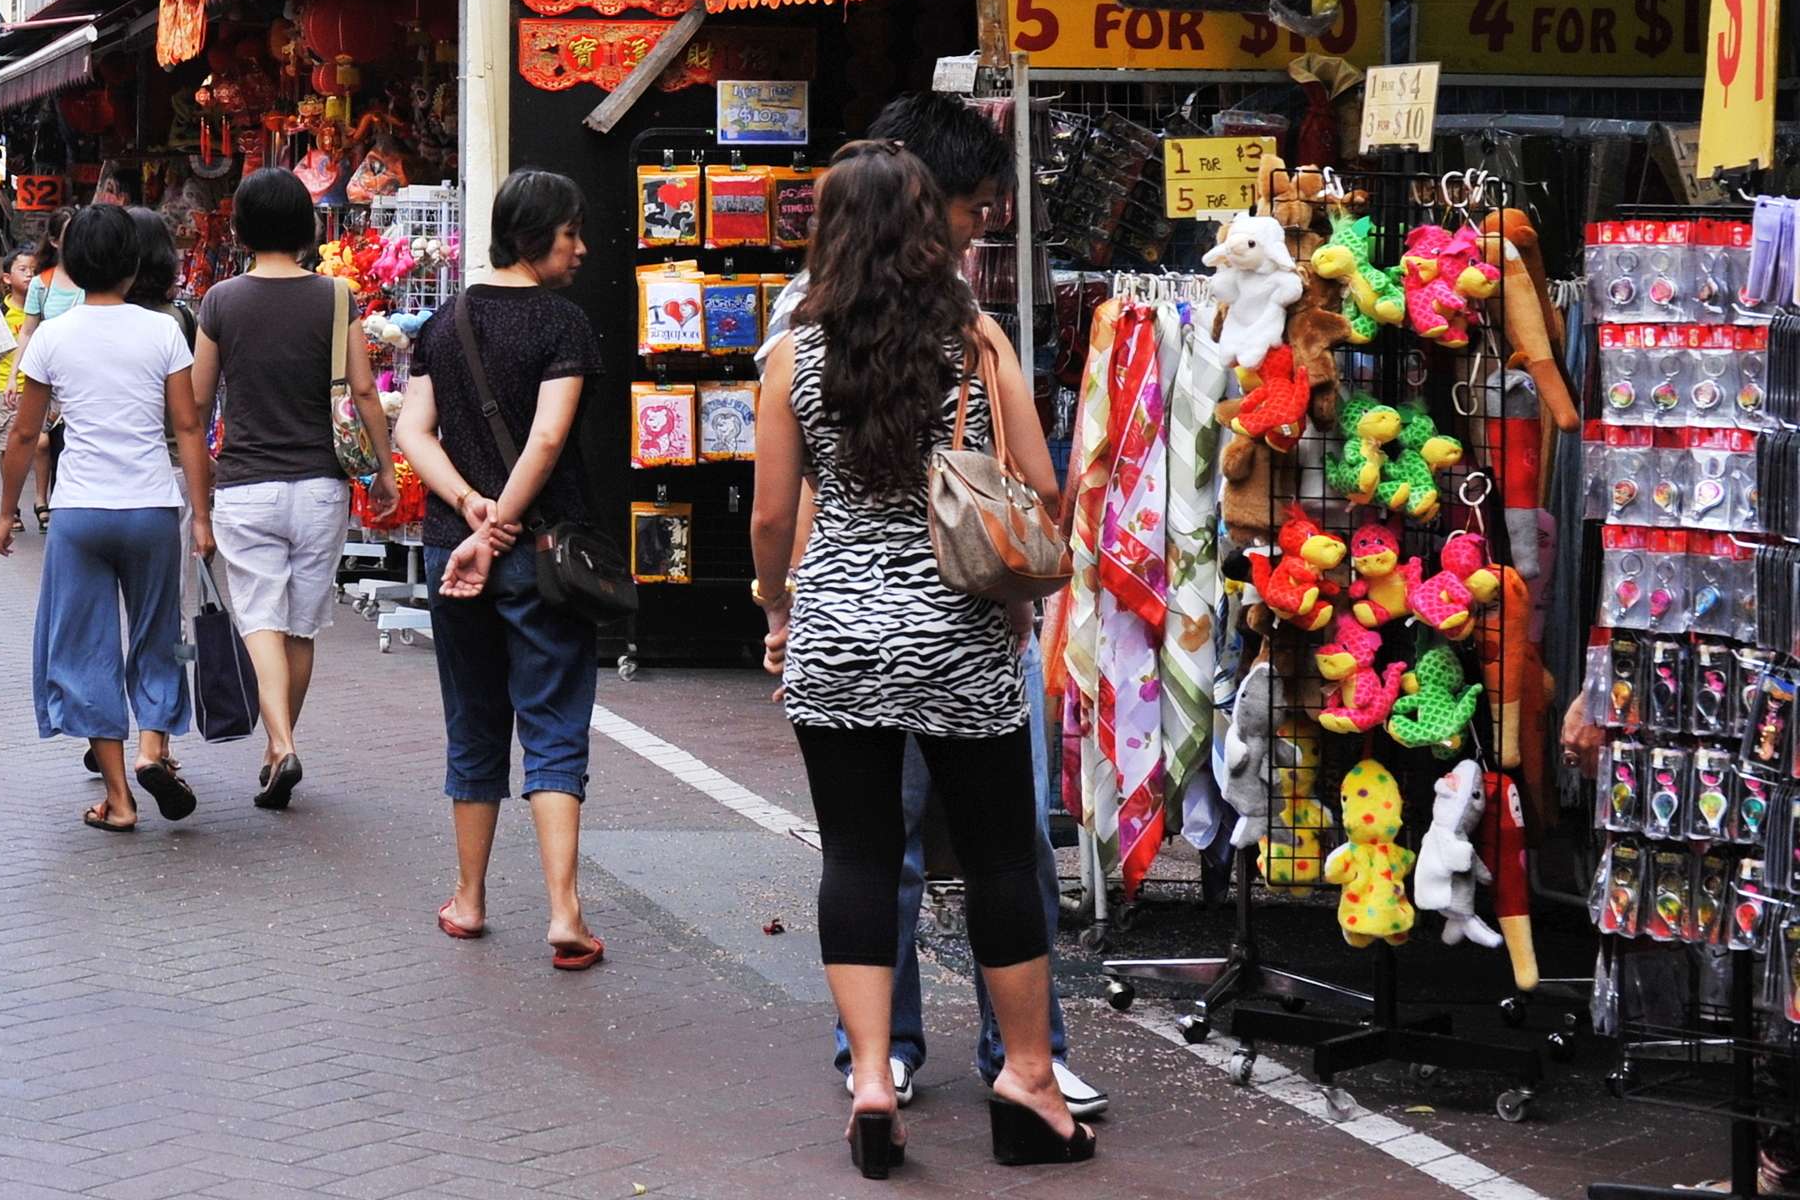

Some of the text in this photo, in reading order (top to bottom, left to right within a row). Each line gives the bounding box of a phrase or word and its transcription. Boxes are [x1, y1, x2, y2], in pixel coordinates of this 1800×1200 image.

[1094, 3, 1205, 50] FOR
[1531, 7, 1617, 53] FOR
[1370, 74, 1377, 98] 1
[1397, 68, 1422, 100] $4
[1366, 112, 1375, 138] 3
[1393, 107, 1424, 139] $10
[1171, 142, 1191, 174] 1
[1199, 157, 1222, 171] FOR
[23, 178, 58, 206] $2
[1176, 187, 1194, 212] 5
[1206, 194, 1229, 208] FOR
